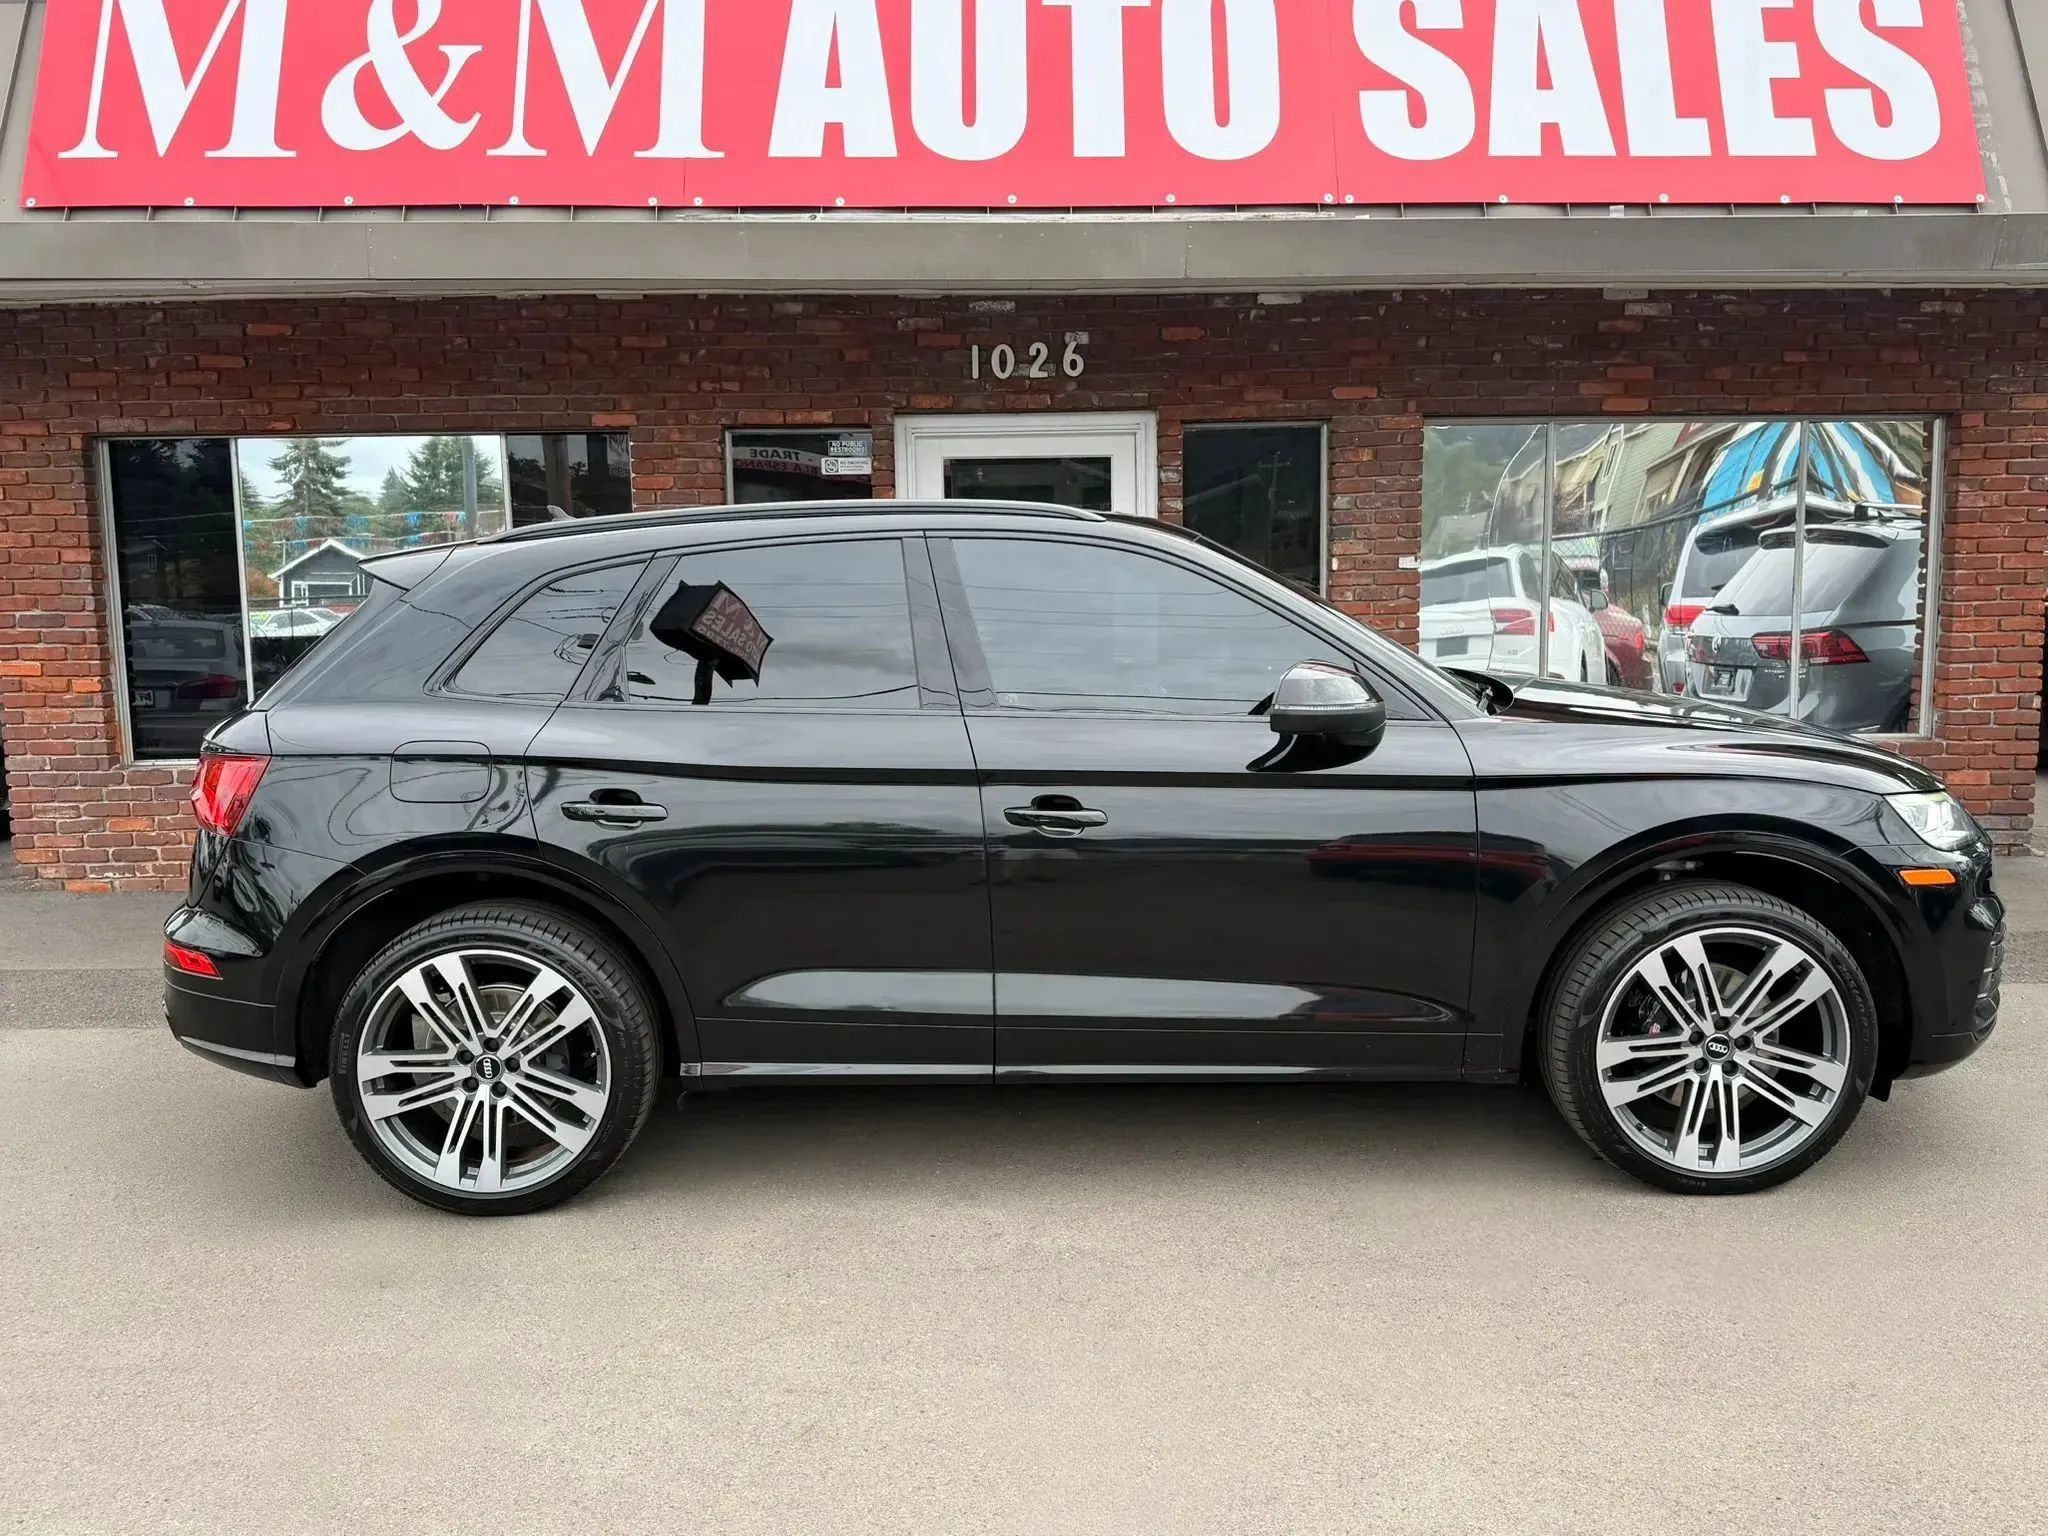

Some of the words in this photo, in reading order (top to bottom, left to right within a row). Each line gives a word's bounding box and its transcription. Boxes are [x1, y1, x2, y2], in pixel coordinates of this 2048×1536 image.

[767, 0, 1281, 161] AUTO
[1352, 0, 1941, 160] SALES
[971, 341, 1085, 380] 1026
